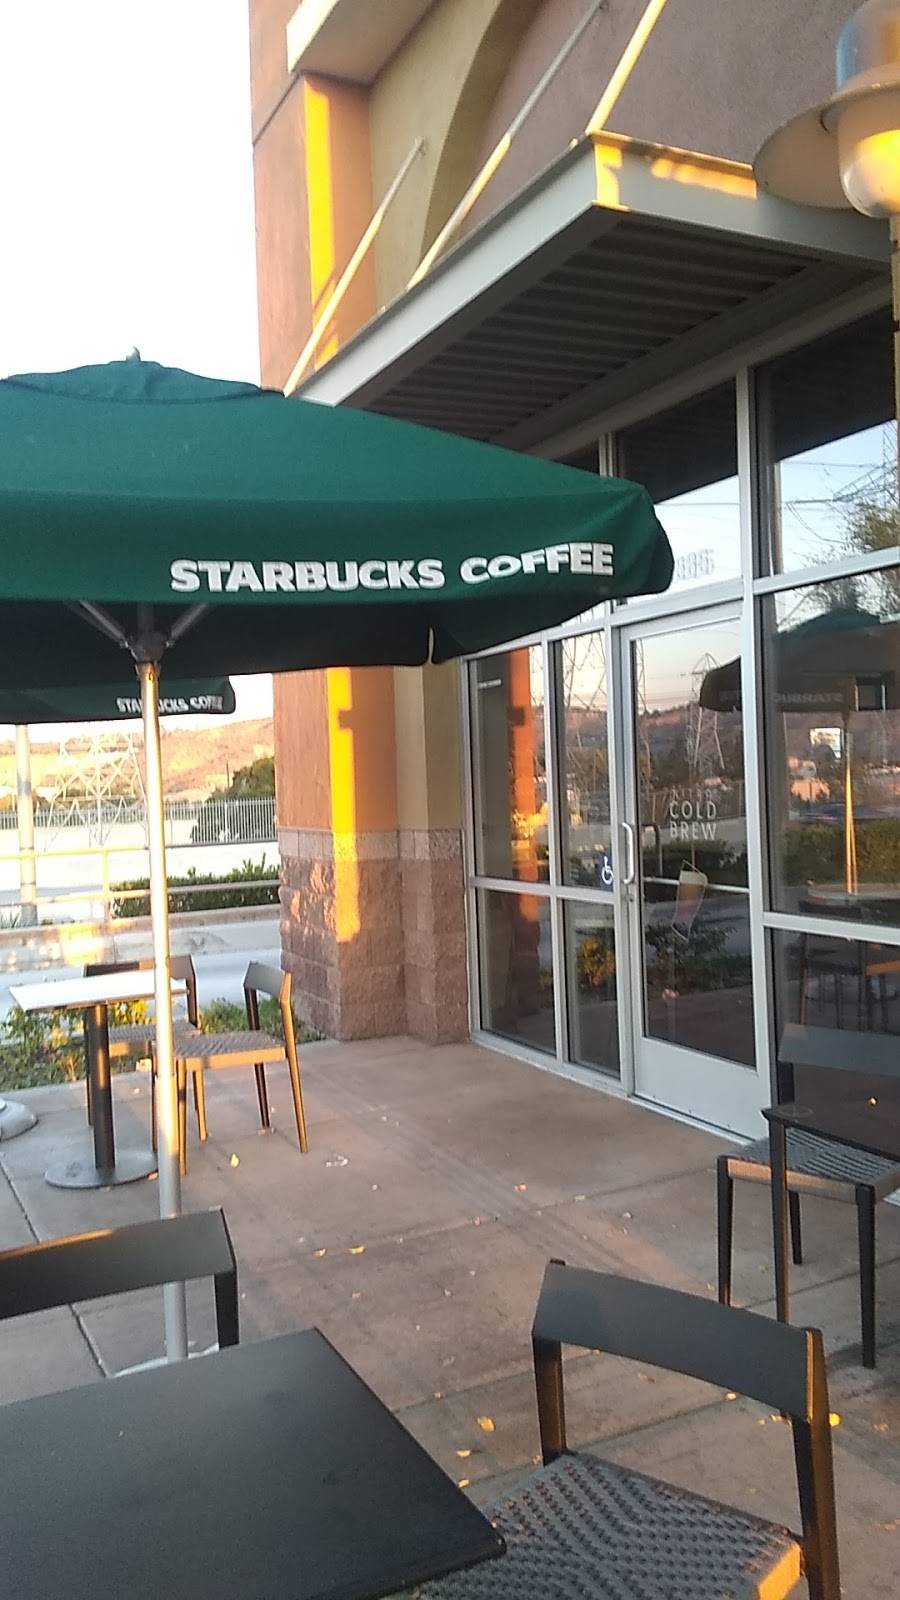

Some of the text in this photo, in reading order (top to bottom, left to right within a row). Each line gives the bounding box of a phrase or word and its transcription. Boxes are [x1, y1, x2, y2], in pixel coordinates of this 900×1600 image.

[169, 542, 614, 593] STARBUCKS COFFEE
[670, 800, 717, 819] COLD
[670, 821, 717, 840] BREW
